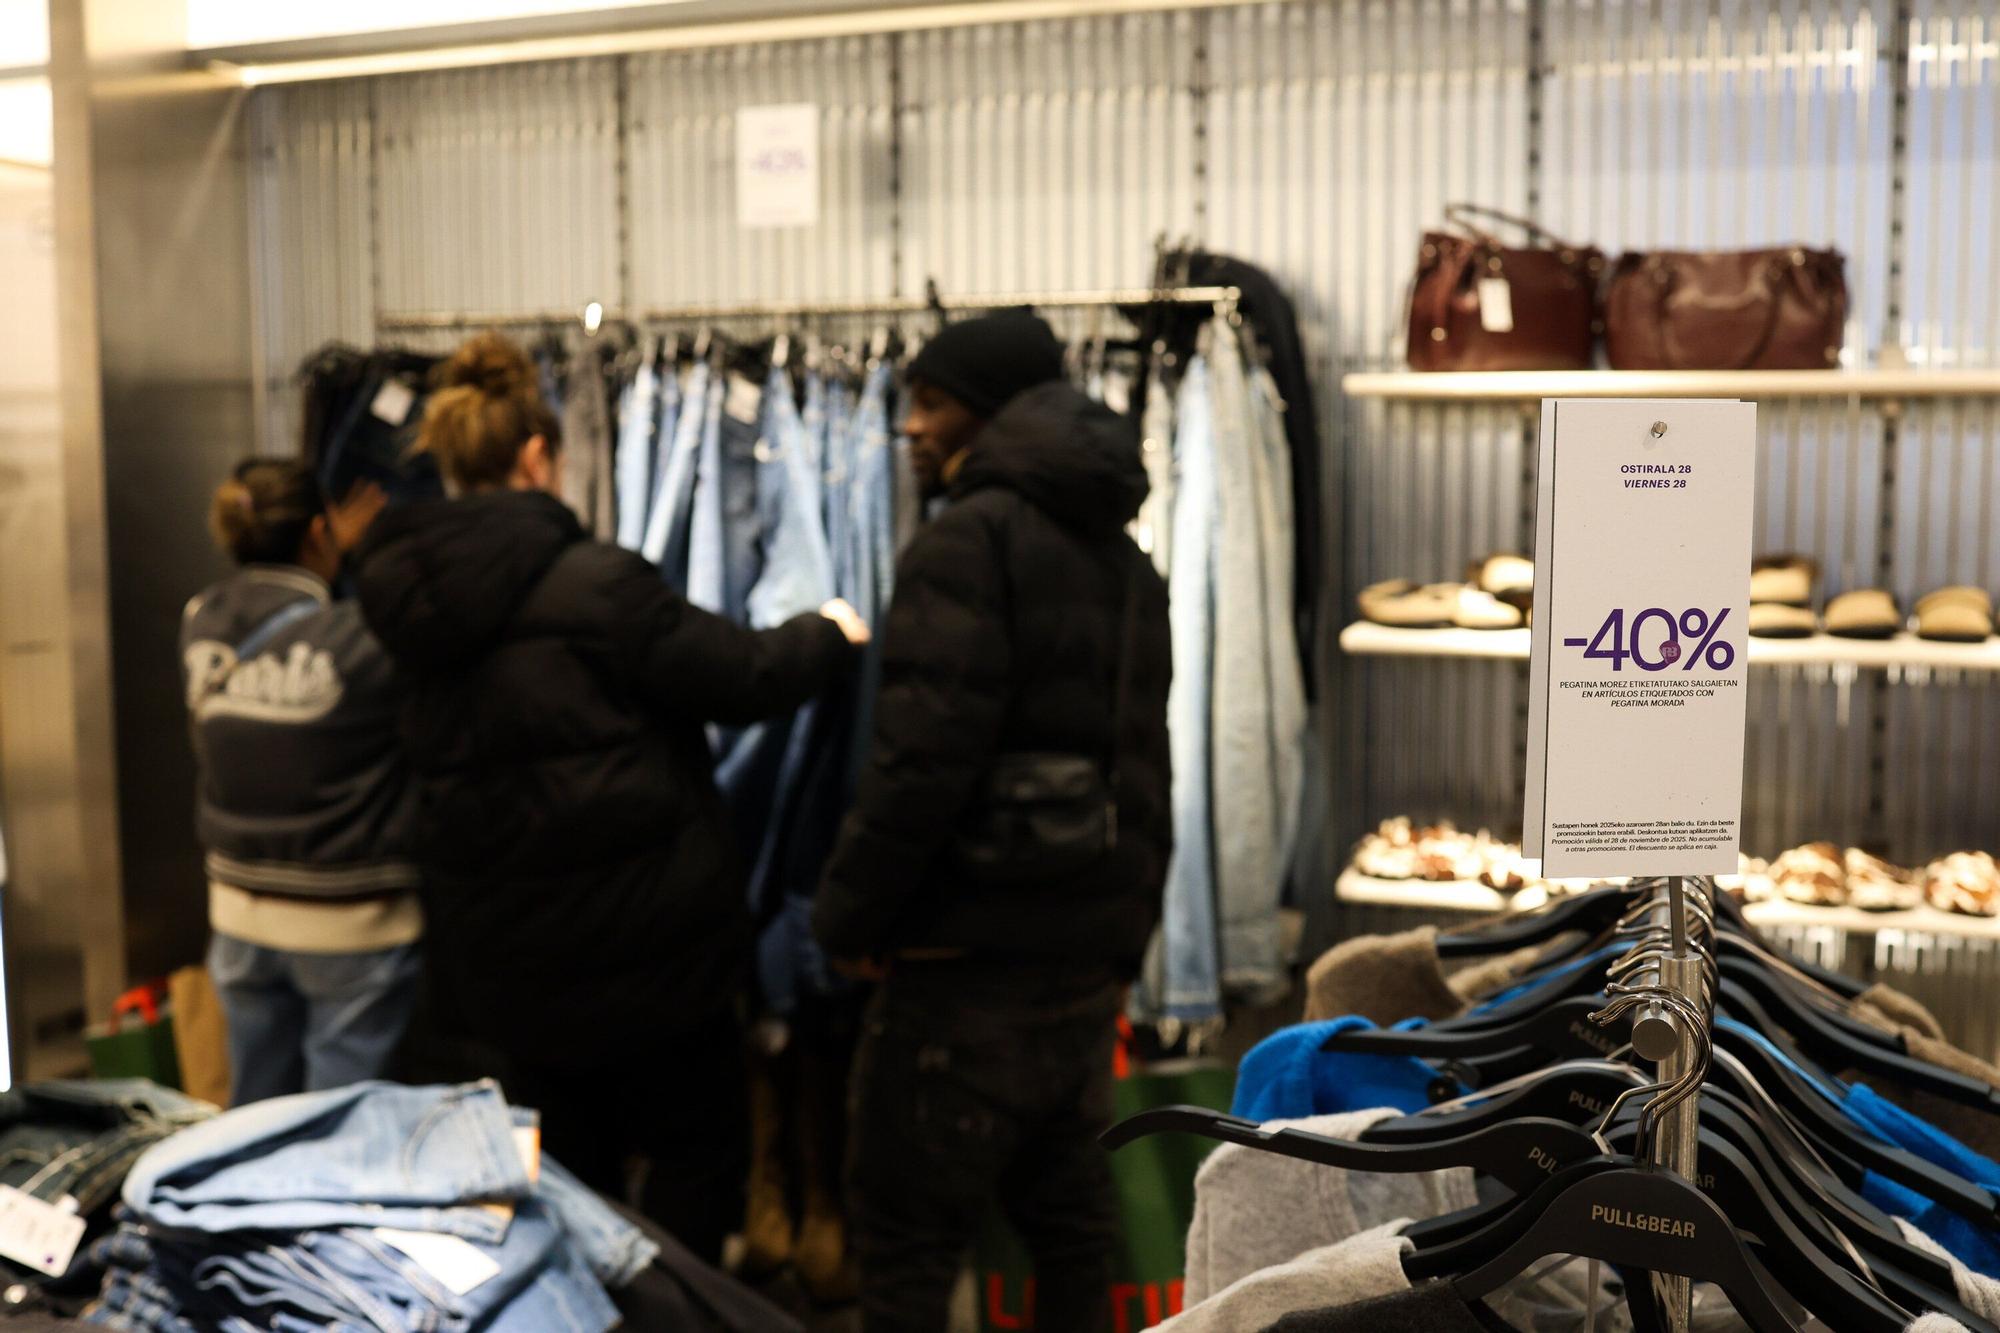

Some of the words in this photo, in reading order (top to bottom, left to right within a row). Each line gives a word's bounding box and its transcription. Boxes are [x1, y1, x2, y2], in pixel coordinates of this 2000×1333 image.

[1620, 464, 1676, 474] OSTIRALA
[1678, 464, 1692, 474] 28
[1624, 479, 1671, 489] VIERNES
[1673, 479, 1687, 489] 28
[1563, 607, 1735, 672] -40%
[1559, 681, 1598, 689] PEGATINA
[1599, 680, 1628, 688] MOREZ
[1629, 680, 1689, 688] ETIKETATUTAKO
[1690, 679, 1738, 687] SALGAIETAN
[1582, 690, 1593, 698] EN
[1594, 689, 1639, 698] ARTÍCULOS
[1640, 689, 1694, 698] ETIQUETADOS
[1695, 689, 1715, 697] CON
[1610, 700, 1649, 708] PEGATINA
[1650, 699, 1685, 707] MORADA
[1552, 822, 1580, 830] Sustapen
[1586, 845, 1627, 853] promociones.
[1591, 1204, 1696, 1239] PULL&BEAR
